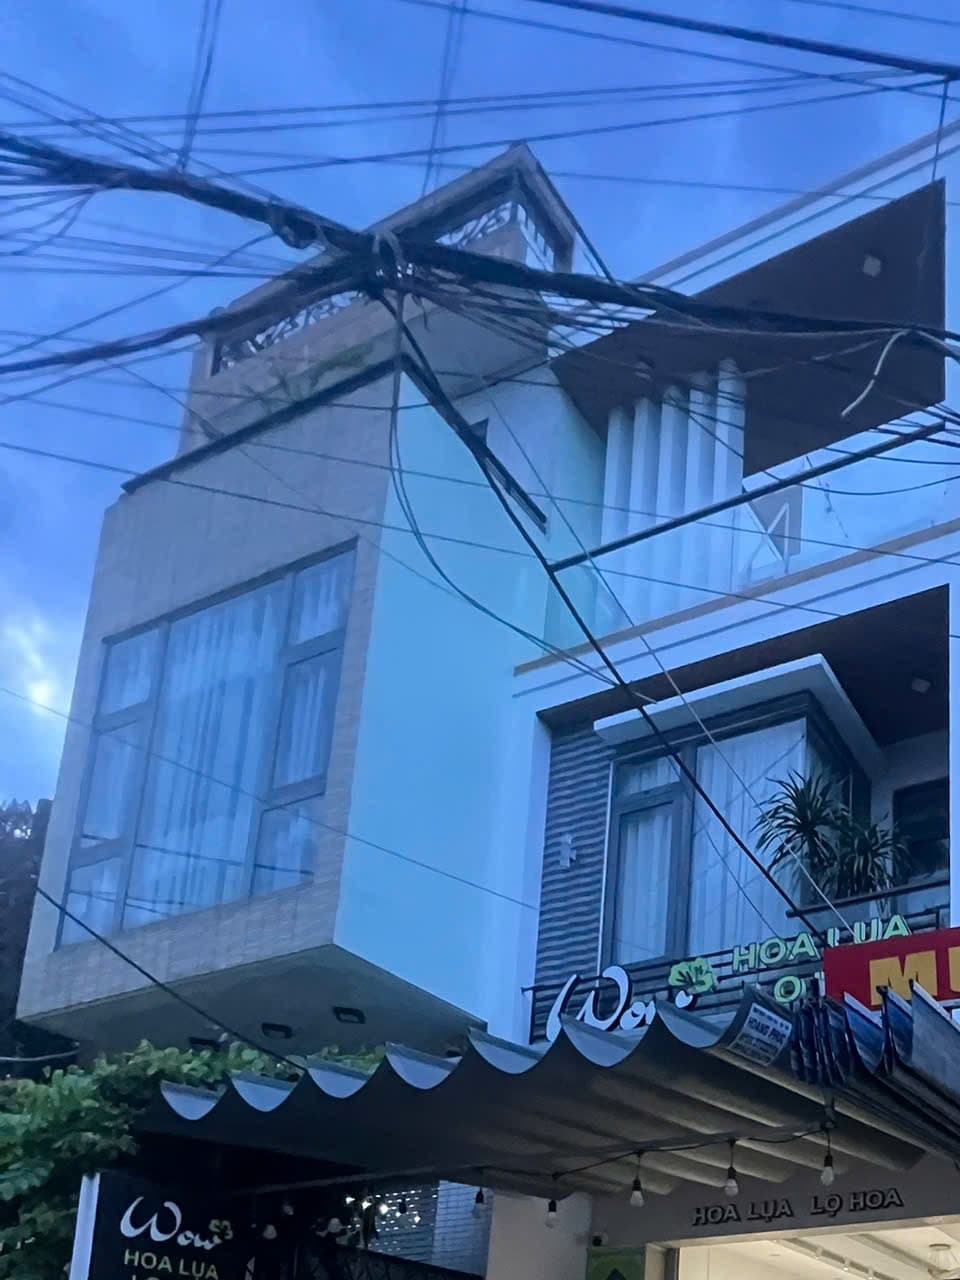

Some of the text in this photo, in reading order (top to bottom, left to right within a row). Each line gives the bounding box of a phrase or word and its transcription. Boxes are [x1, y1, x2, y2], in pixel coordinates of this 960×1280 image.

[732, 932, 820, 972] HOA
[692, 1203, 741, 1226] HOA
[810, 1194, 842, 1218] LỌ
[849, 1188, 904, 1212] HOA
[124, 1248, 219, 1280] HOA LỤA
